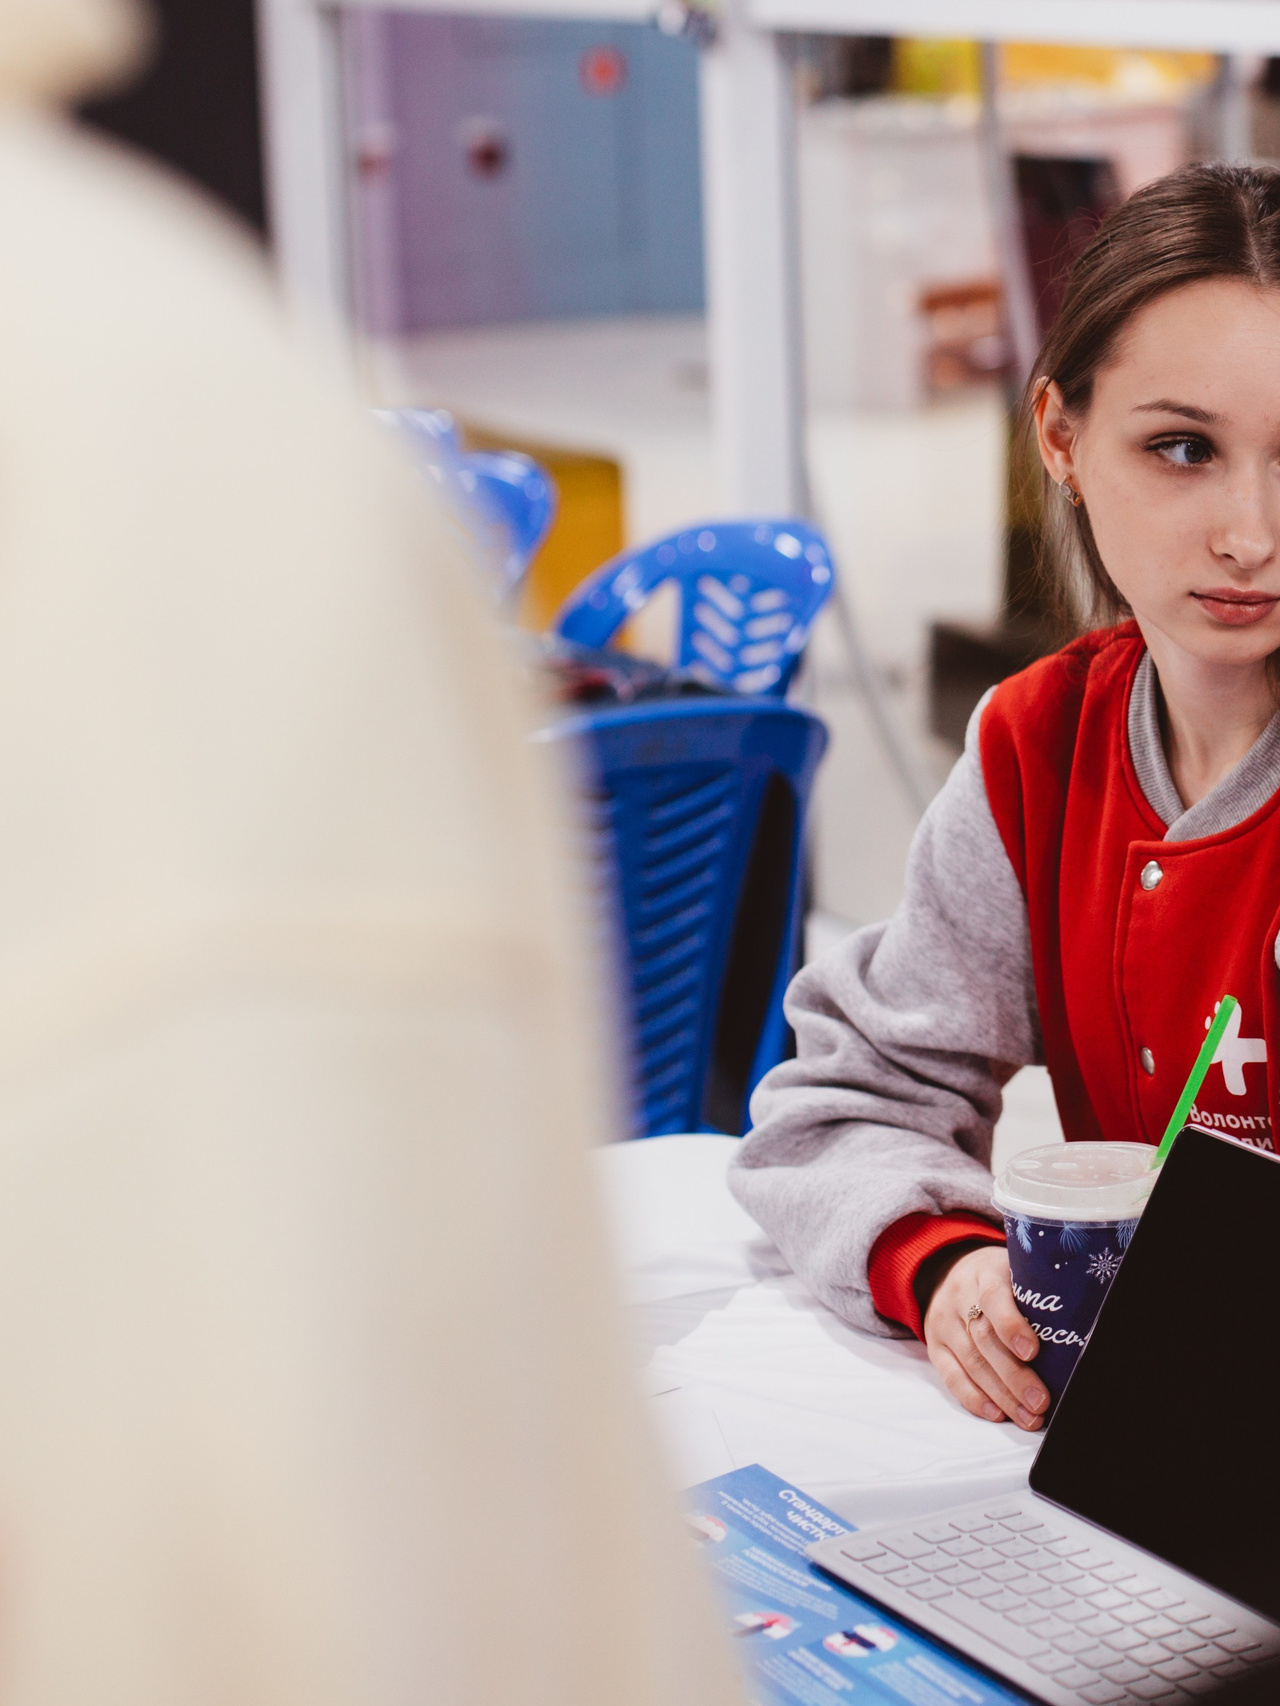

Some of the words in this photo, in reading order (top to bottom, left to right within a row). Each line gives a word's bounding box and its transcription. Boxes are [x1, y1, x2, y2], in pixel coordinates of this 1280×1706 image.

[1189, 1102, 1272, 1129] Волонт
[1009, 1268, 1064, 1312] има
[778, 1489, 850, 1536] Стандарт
[786, 1510, 829, 1541] чистк
